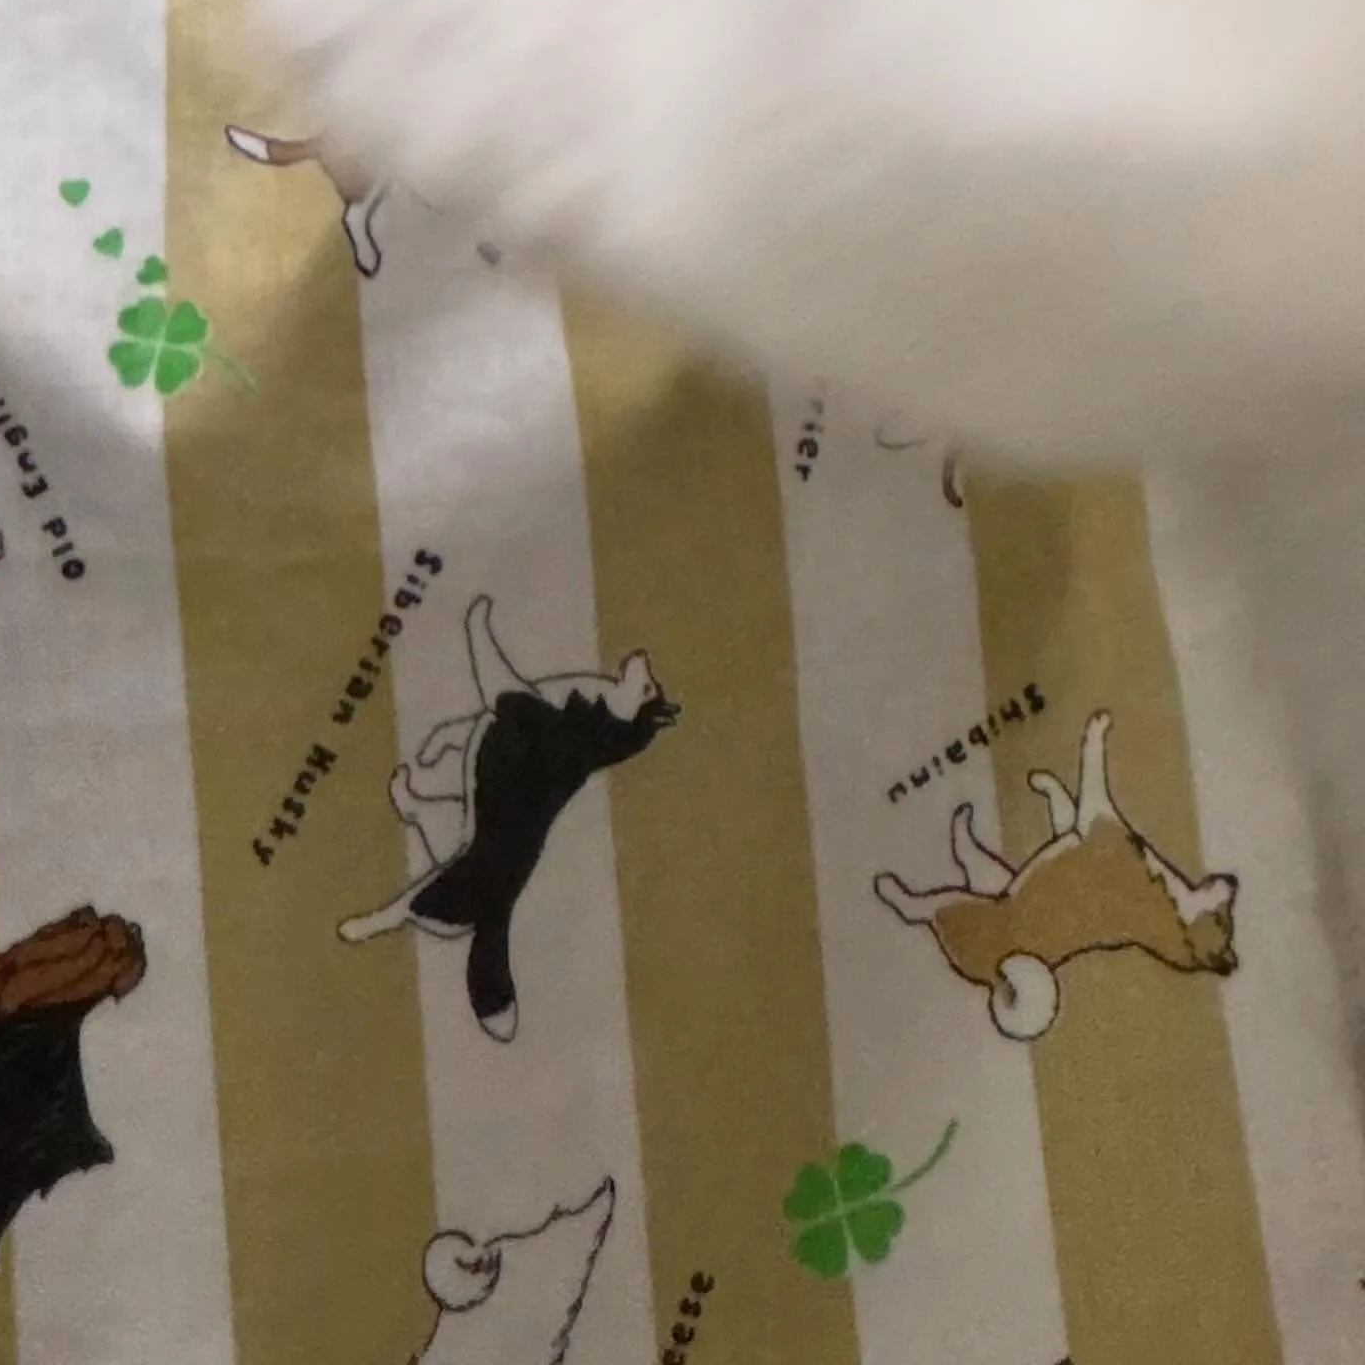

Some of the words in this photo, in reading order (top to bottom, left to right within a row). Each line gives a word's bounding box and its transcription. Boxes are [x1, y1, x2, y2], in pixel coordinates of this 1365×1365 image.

[41, 515, 86, 581] Old
[332, 548, 443, 725] Siberian
[888, 682, 1046, 804] Shibainu
[253, 743, 338, 867] Husky
